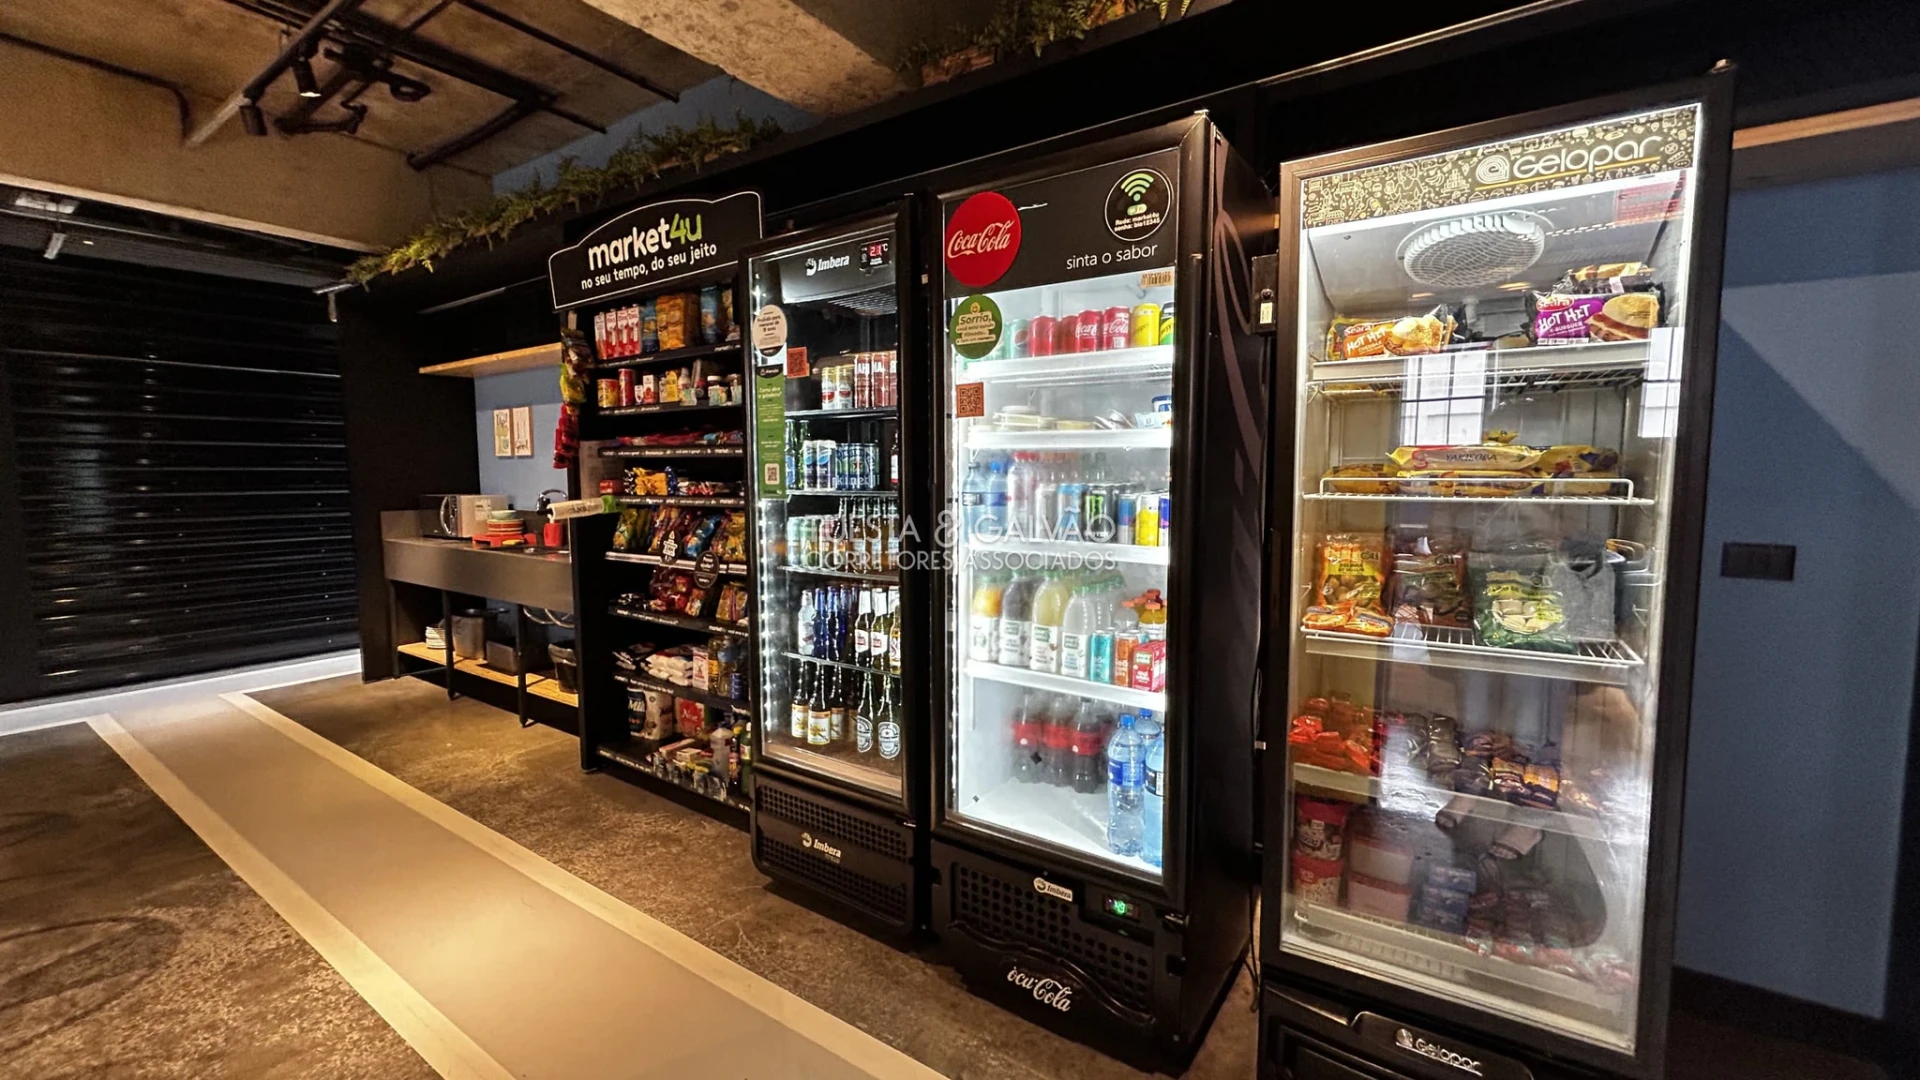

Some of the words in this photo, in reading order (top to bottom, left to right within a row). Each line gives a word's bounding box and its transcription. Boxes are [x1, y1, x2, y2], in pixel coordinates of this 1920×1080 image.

[588, 213, 703, 271] market4u
[581, 277, 593, 290] no
[595, 273, 611, 288] seu
[613, 263, 649, 284] tempo,
[651, 256, 665, 272] do
[668, 252, 687, 268] seu
[690, 242, 718, 264] jeito
[818, 255, 850, 272] Imbera
[1066, 254, 1098, 270] sinta
[1102, 251, 1112, 264] o
[1116, 243, 1158, 263] sabor
[960, 313, 991, 325] Sorria,
[1538, 312, 1563, 333] HOT
[1564, 304, 1591, 323] HIT
[1346, 334, 1366, 357] HOT
[813, 839, 842, 858] Imbera
[1046, 885, 1073, 899] Imbera
